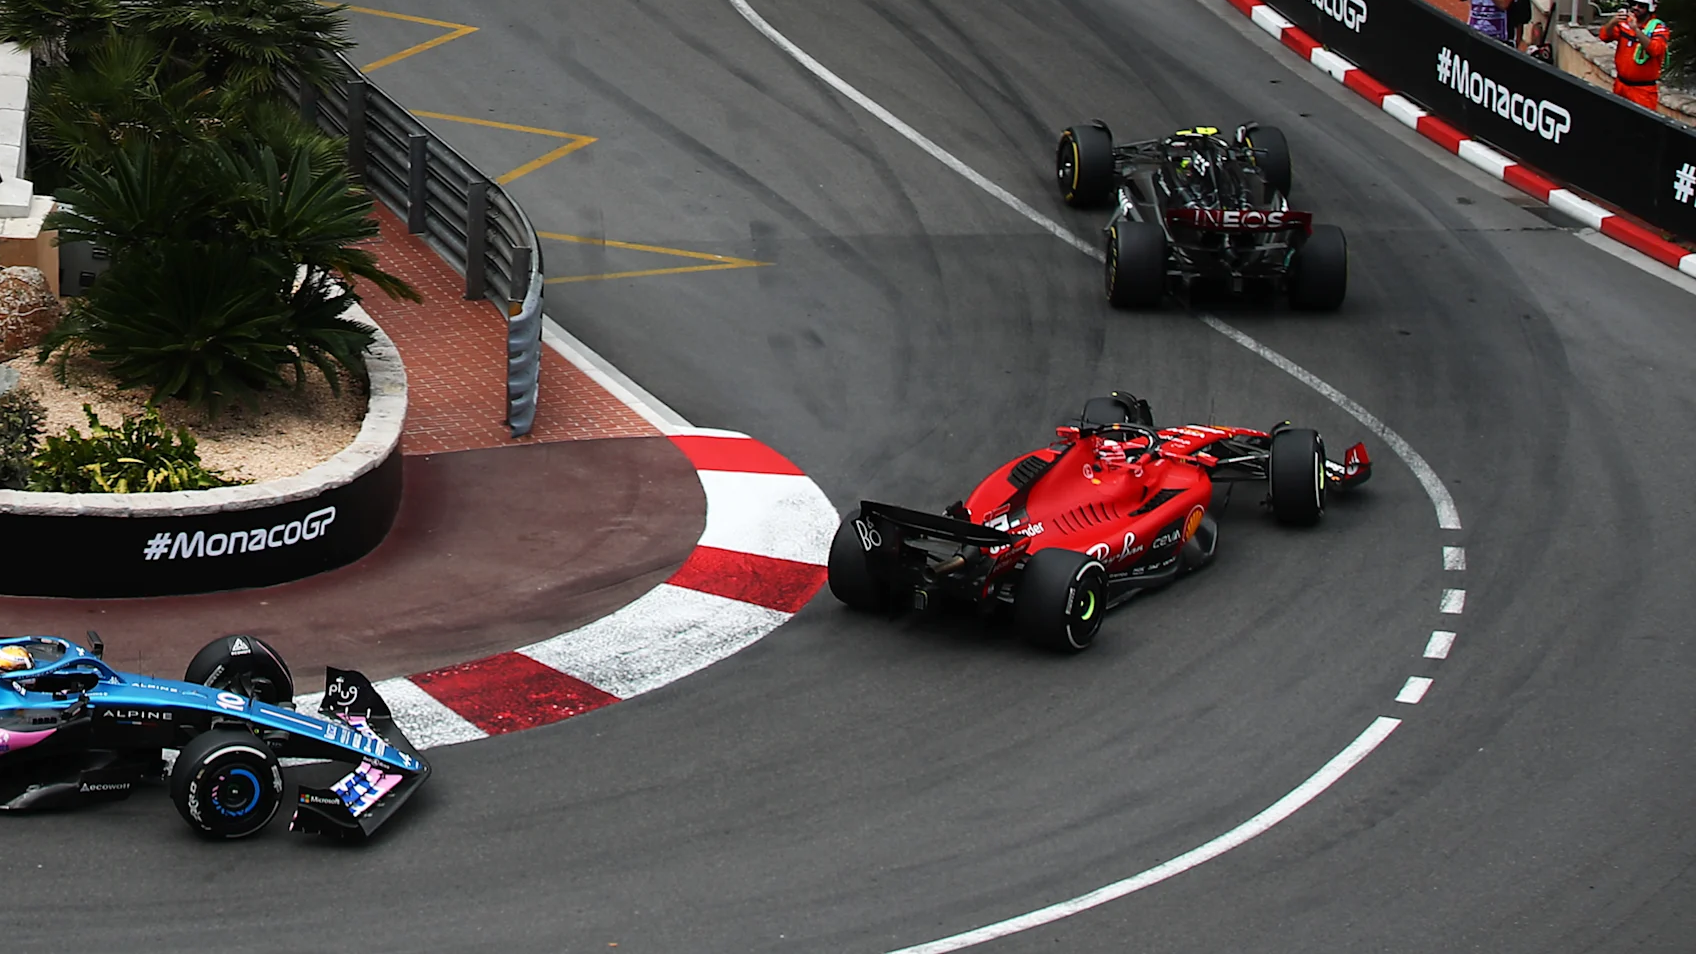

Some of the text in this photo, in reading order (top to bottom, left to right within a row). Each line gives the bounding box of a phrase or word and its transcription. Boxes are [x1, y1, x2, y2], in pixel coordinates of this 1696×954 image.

[1436, 46, 1572, 144] #MonacoGP
[1195, 209, 1286, 229] INEOS
[143, 506, 336, 561] #MonacoGP
[132, 683, 178, 693] ALPINE
[216, 692, 246, 712] 10
[103, 709, 173, 721] ALPINE
[310, 796, 341, 806] Microsoft
